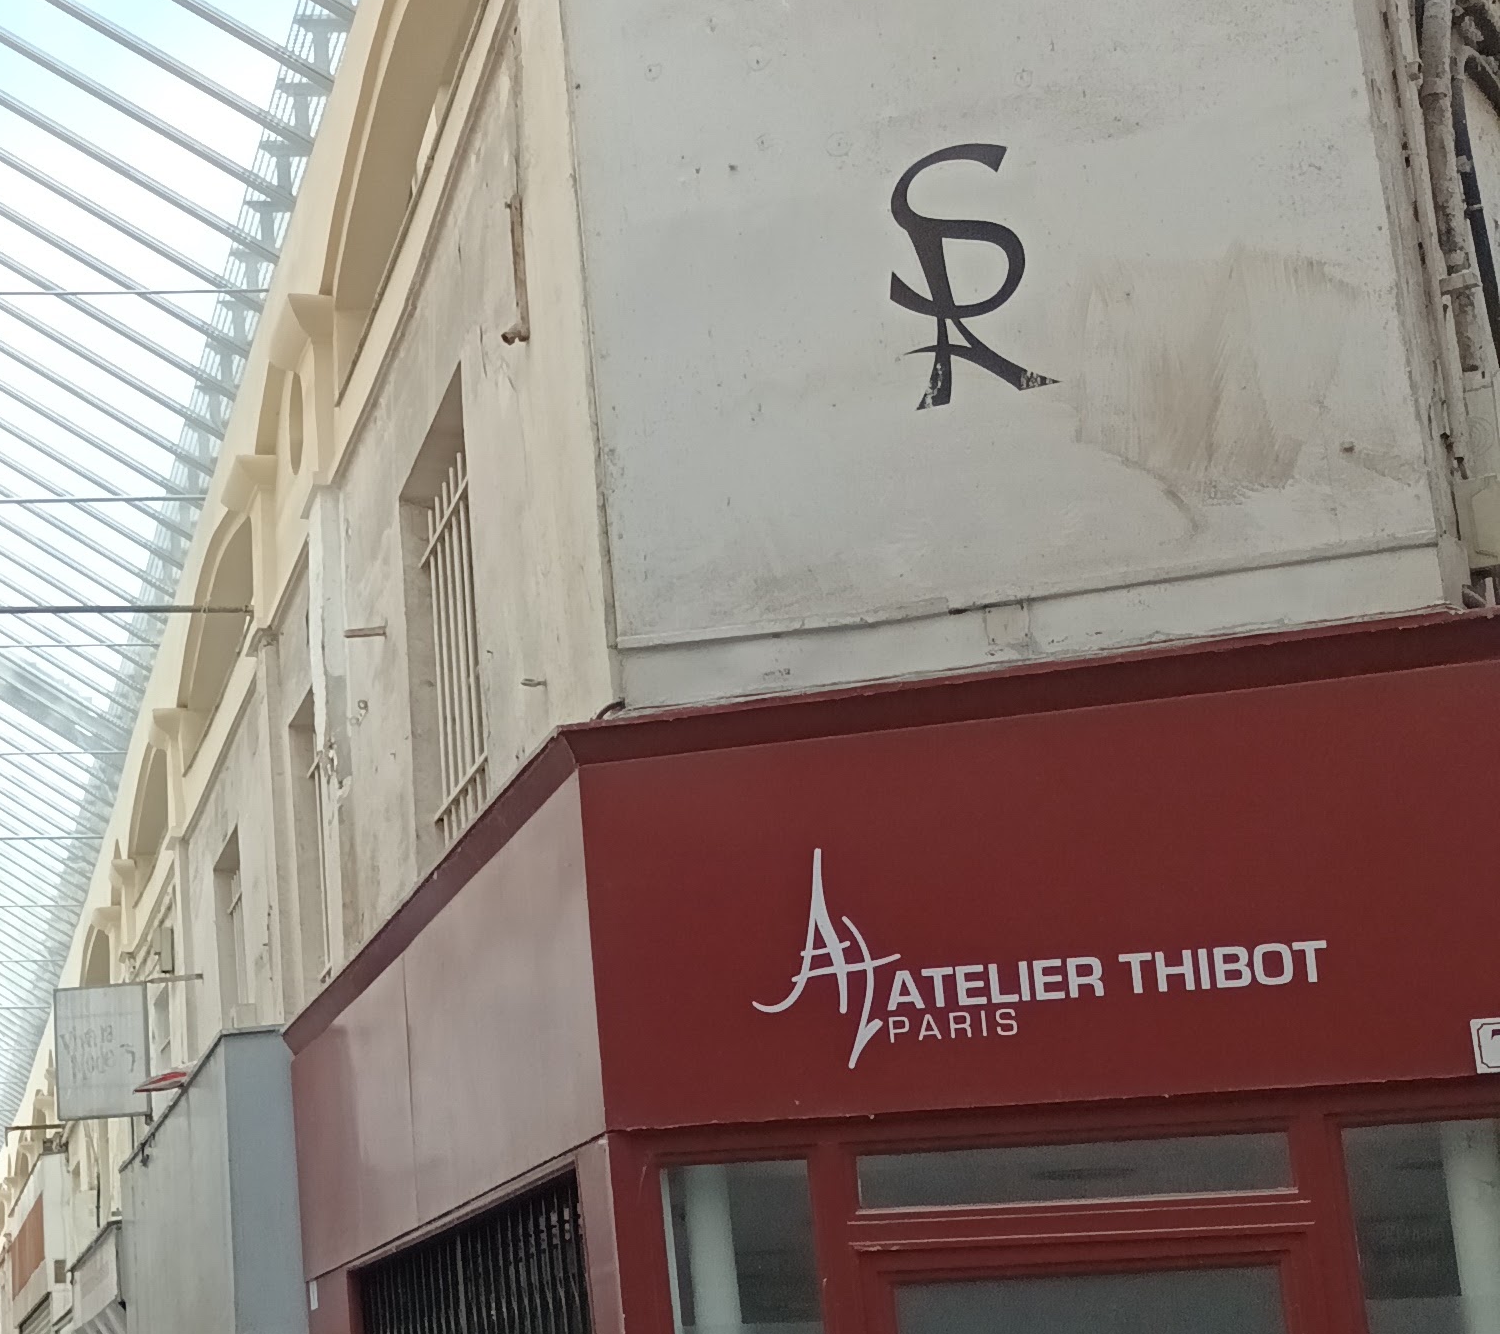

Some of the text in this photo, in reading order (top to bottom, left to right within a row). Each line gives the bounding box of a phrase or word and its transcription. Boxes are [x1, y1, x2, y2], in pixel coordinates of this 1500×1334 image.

[887, 939, 1328, 1011] ATELIER THIBOT
[887, 1008, 1019, 1043] PARIS
